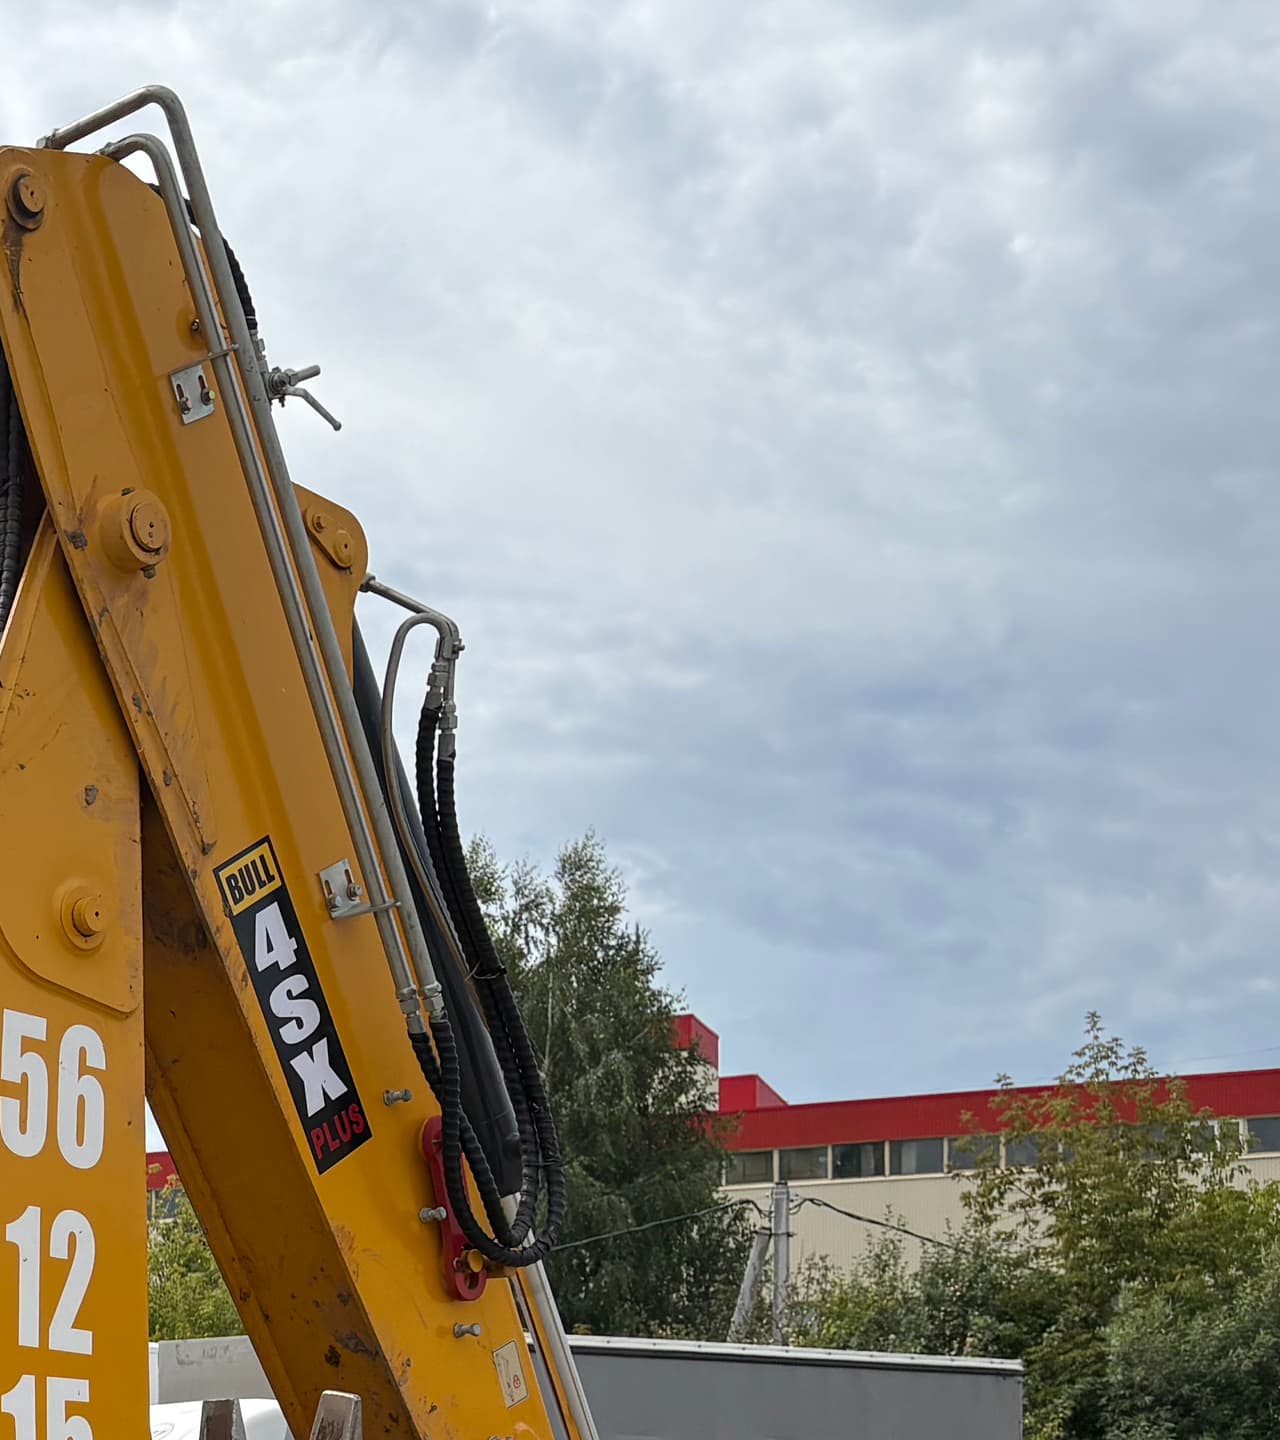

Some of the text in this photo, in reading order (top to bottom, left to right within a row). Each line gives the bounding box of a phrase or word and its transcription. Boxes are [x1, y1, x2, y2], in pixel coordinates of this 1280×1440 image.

[225, 854, 276, 906] BULL
[255, 901, 349, 1118] 4SX
[0, 1008, 107, 1169] 56
[310, 1103, 366, 1161] PLUS
[5, 1205, 96, 1356] 12
